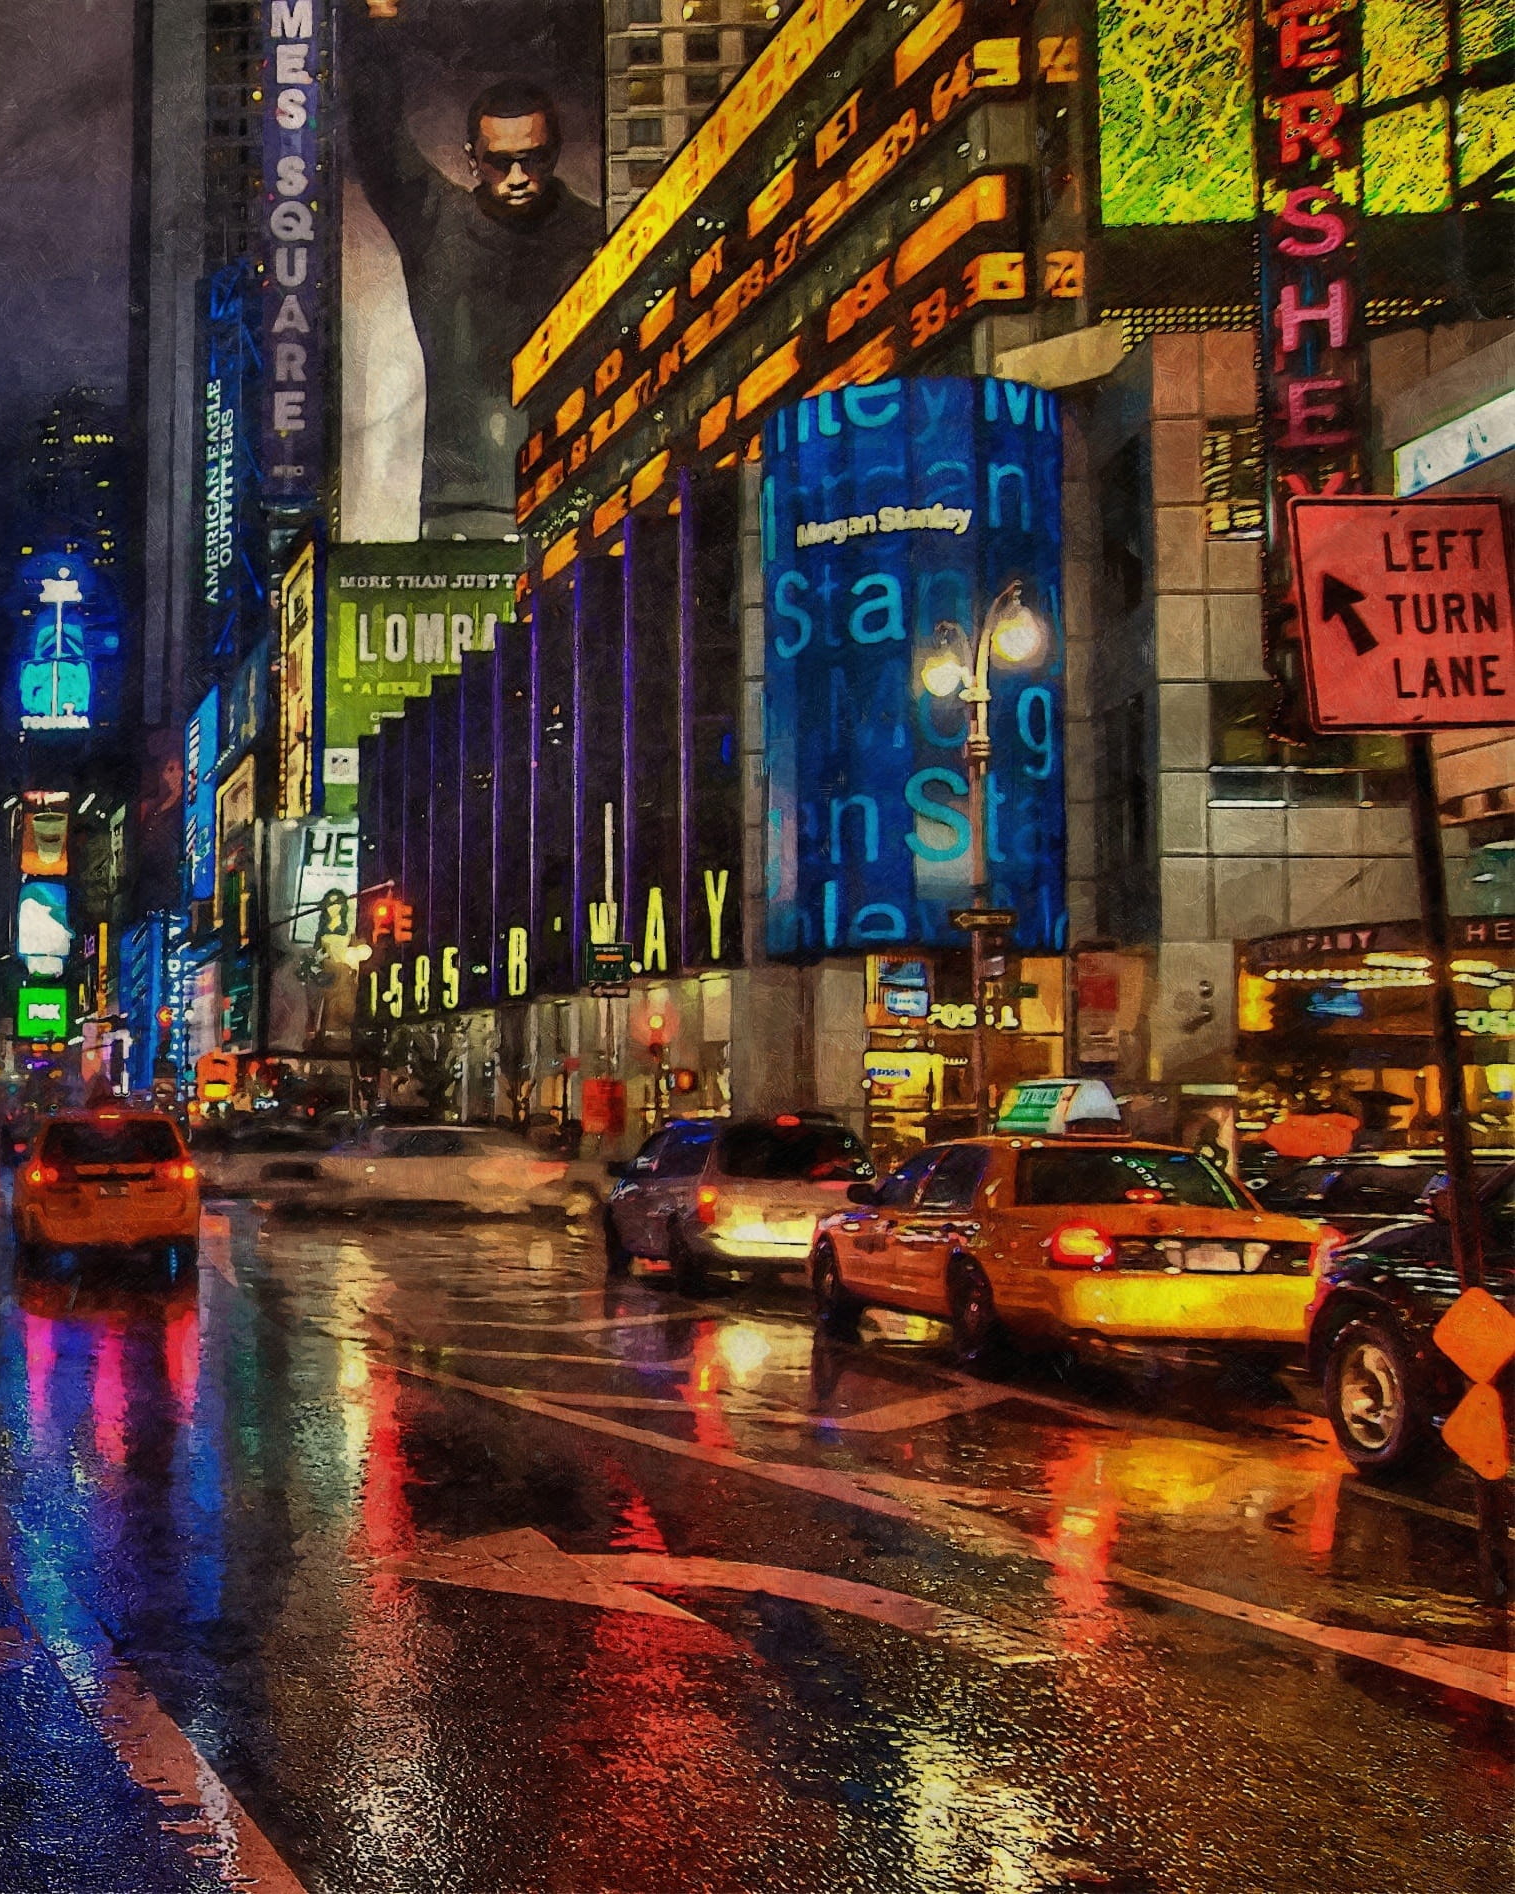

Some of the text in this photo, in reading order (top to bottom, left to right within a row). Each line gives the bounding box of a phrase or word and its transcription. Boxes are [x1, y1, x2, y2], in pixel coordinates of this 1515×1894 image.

[270, 156, 315, 432] SQUARE
[204, 379, 222, 606] AMERICAN EAGLE
[219, 408, 234, 569] OUTFITTERS
[796, 502, 973, 548] Morgan Stanley
[1382, 528, 1484, 573] LEFT
[339, 574, 392, 589] MORE
[396, 574, 448, 589] THAN
[450, 573, 500, 589] JUST
[1385, 592, 1499, 636] TURN
[1392, 654, 1506, 699] LANE
[370, 946, 460, 1018] 1585
